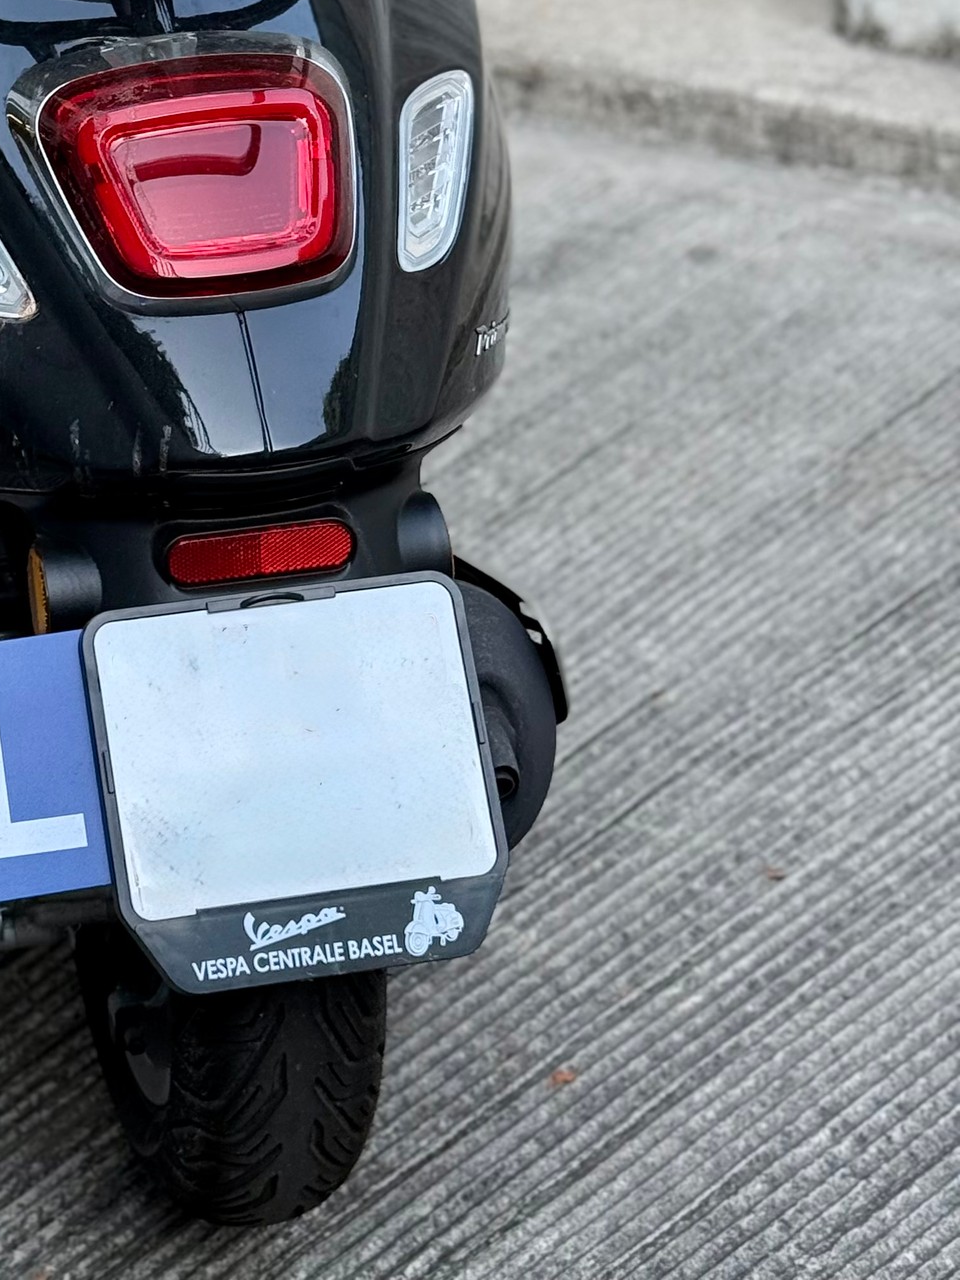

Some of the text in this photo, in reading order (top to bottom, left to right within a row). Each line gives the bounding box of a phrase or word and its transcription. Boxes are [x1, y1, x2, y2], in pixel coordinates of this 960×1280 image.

[243, 906, 346, 951] Vespa
[192, 934, 403, 982] VESPA CENTRALE BASEL
